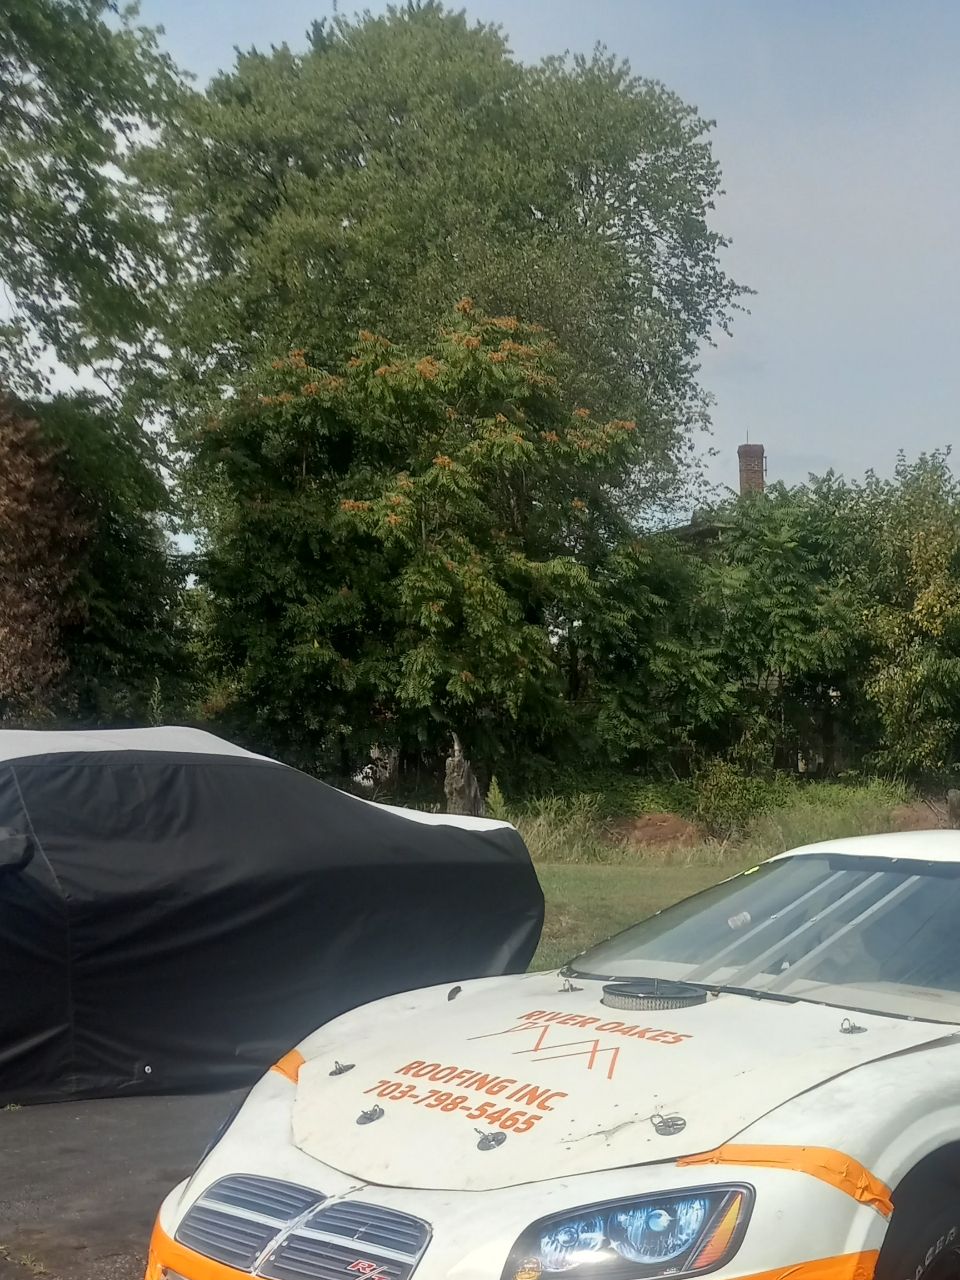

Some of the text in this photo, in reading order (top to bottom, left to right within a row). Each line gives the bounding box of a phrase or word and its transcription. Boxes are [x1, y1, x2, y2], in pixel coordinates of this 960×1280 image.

[517, 1010, 694, 1045] RIVER OAKES
[362, 1079, 544, 1134] 703-798-5465
[394, 1060, 568, 1112] ROOFING INC.
